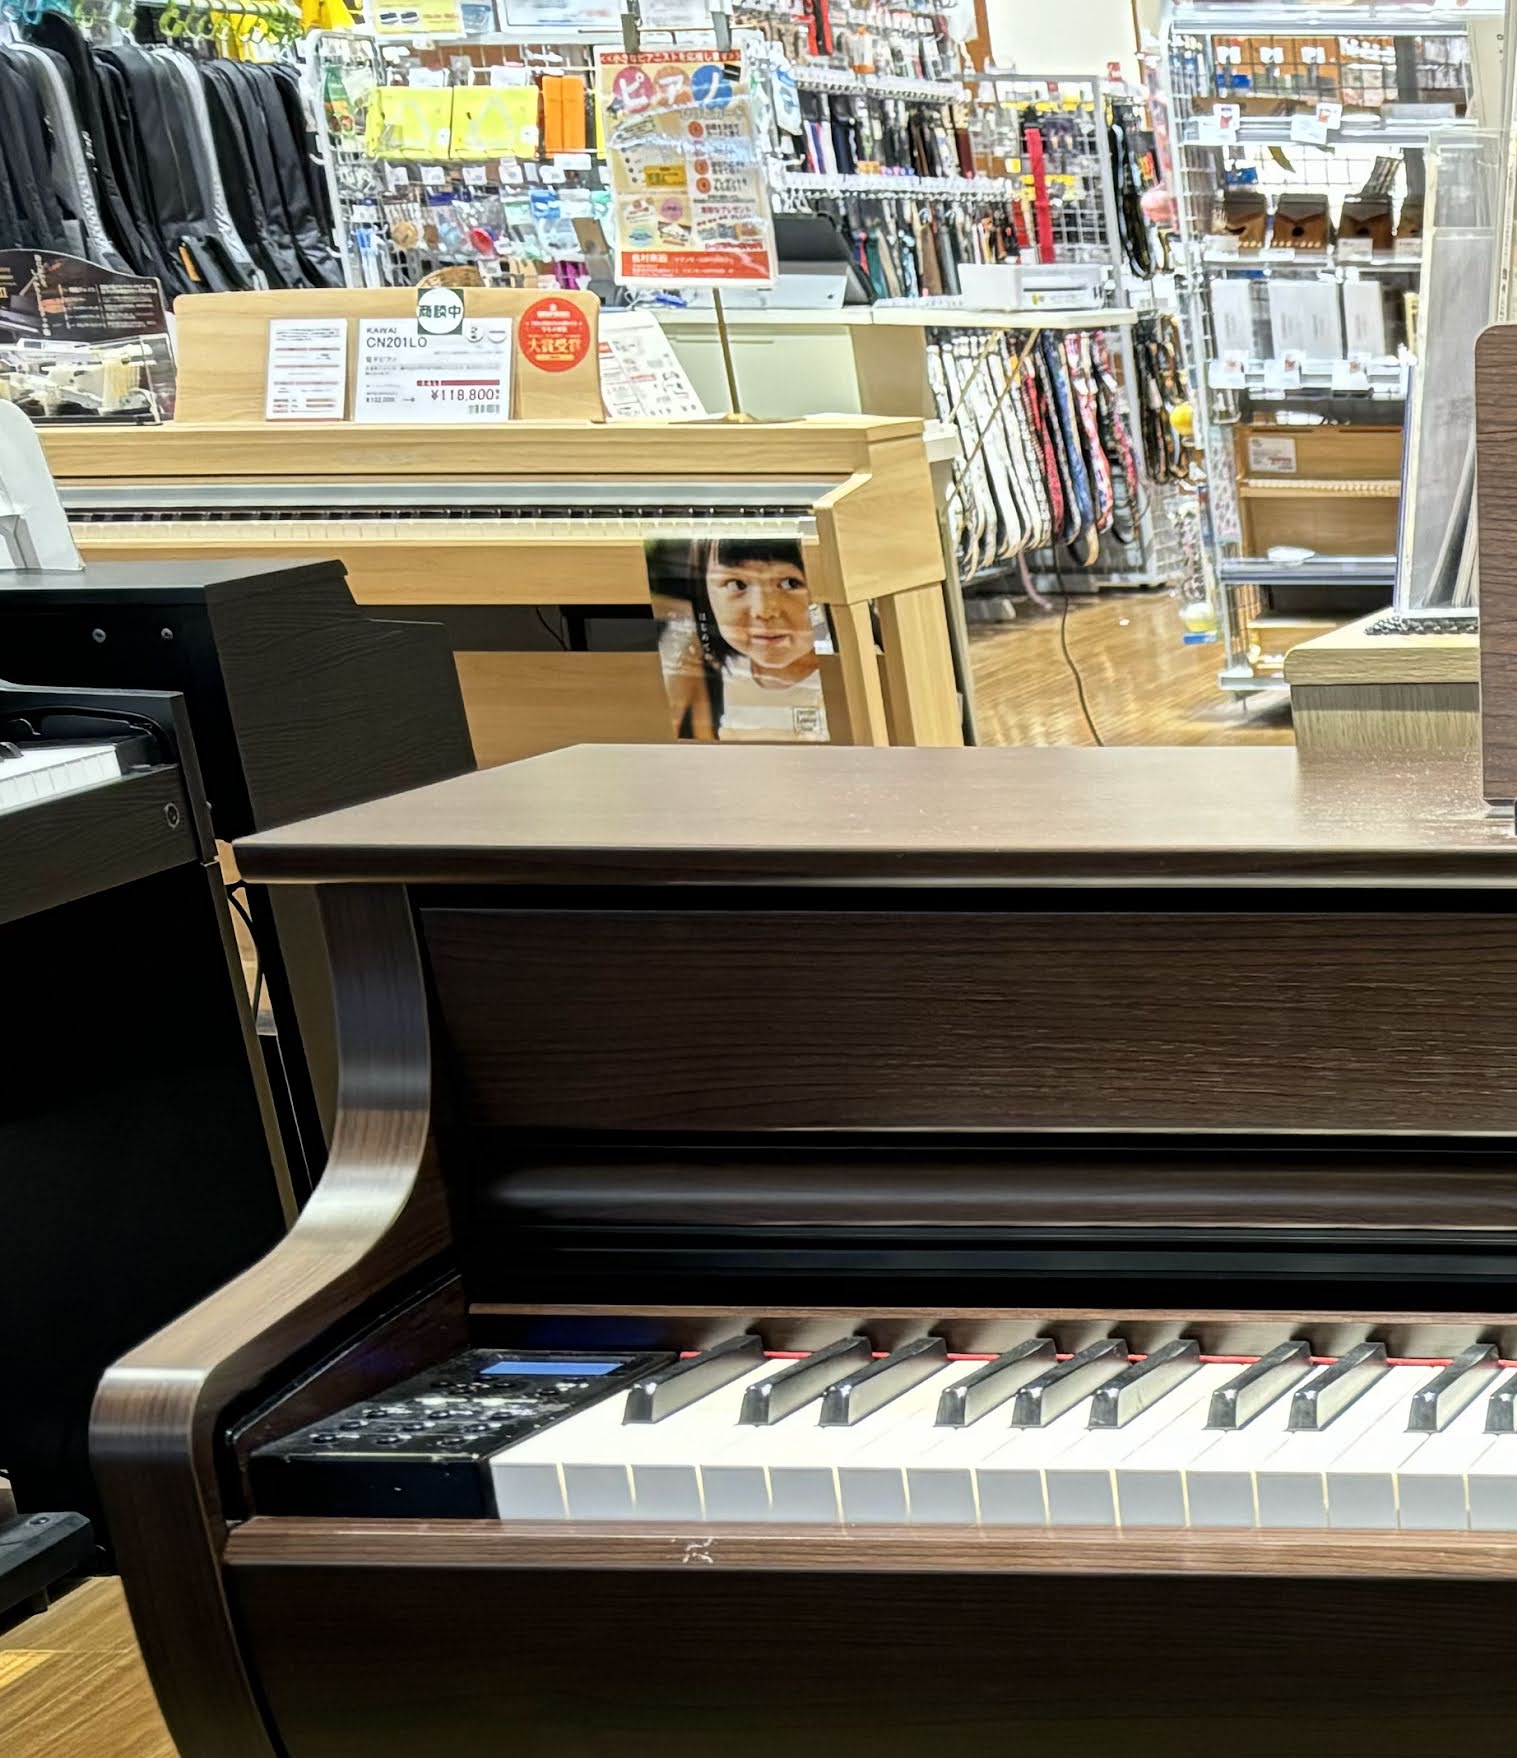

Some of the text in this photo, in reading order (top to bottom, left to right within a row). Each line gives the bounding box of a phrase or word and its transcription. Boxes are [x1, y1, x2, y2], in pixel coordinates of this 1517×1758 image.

[619, 72, 720, 106] ピアノ
[418, 304, 461, 319] 商談中
[366, 336, 428, 348] CN201LO
[431, 388, 494, 402] ¥118,800
